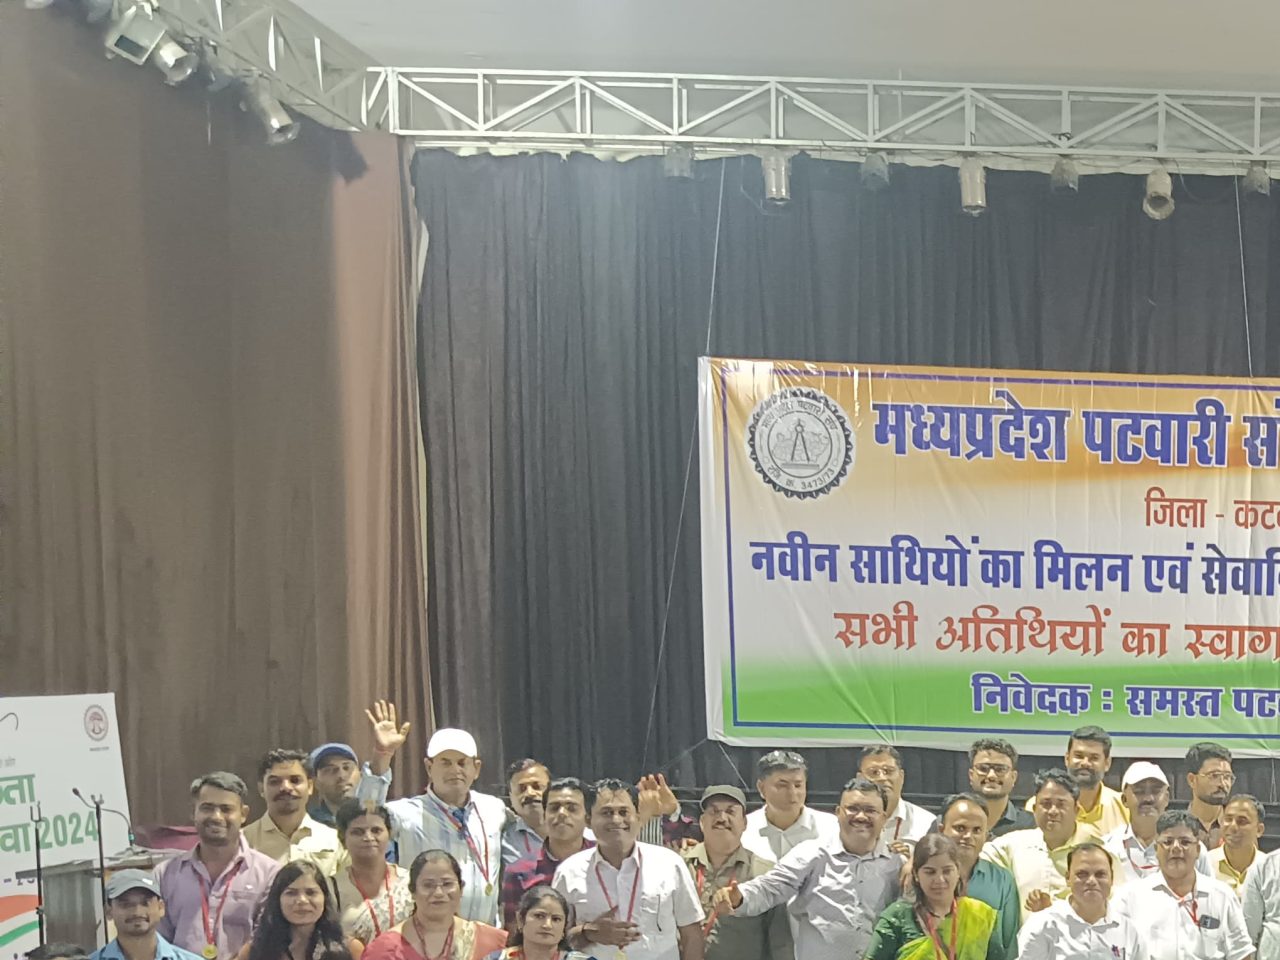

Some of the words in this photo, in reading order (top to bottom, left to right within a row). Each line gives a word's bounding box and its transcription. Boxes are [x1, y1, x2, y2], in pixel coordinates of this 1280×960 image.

[872, 390, 1070, 460] मध्यप्रदेश
[1083, 399, 1231, 468] पटवारी
[801, 467, 835, 491] 3473/73
[1145, 488, 1207, 528] जिला
[750, 531, 839, 582] नवीन
[849, 535, 985, 587] साथियों
[980, 550, 1024, 588] का
[1034, 540, 1132, 592] मिलन
[1142, 543, 1195, 594] एवं
[835, 601, 918, 649] सभी
[936, 605, 1111, 655] अतिथियों
[1121, 623, 1170, 657] का
[972, 673, 1093, 714] निवेदक
[1125, 686, 1223, 718] समस्त
[0, 774, 35, 805] ता
[39, 810, 98, 850] 2024
